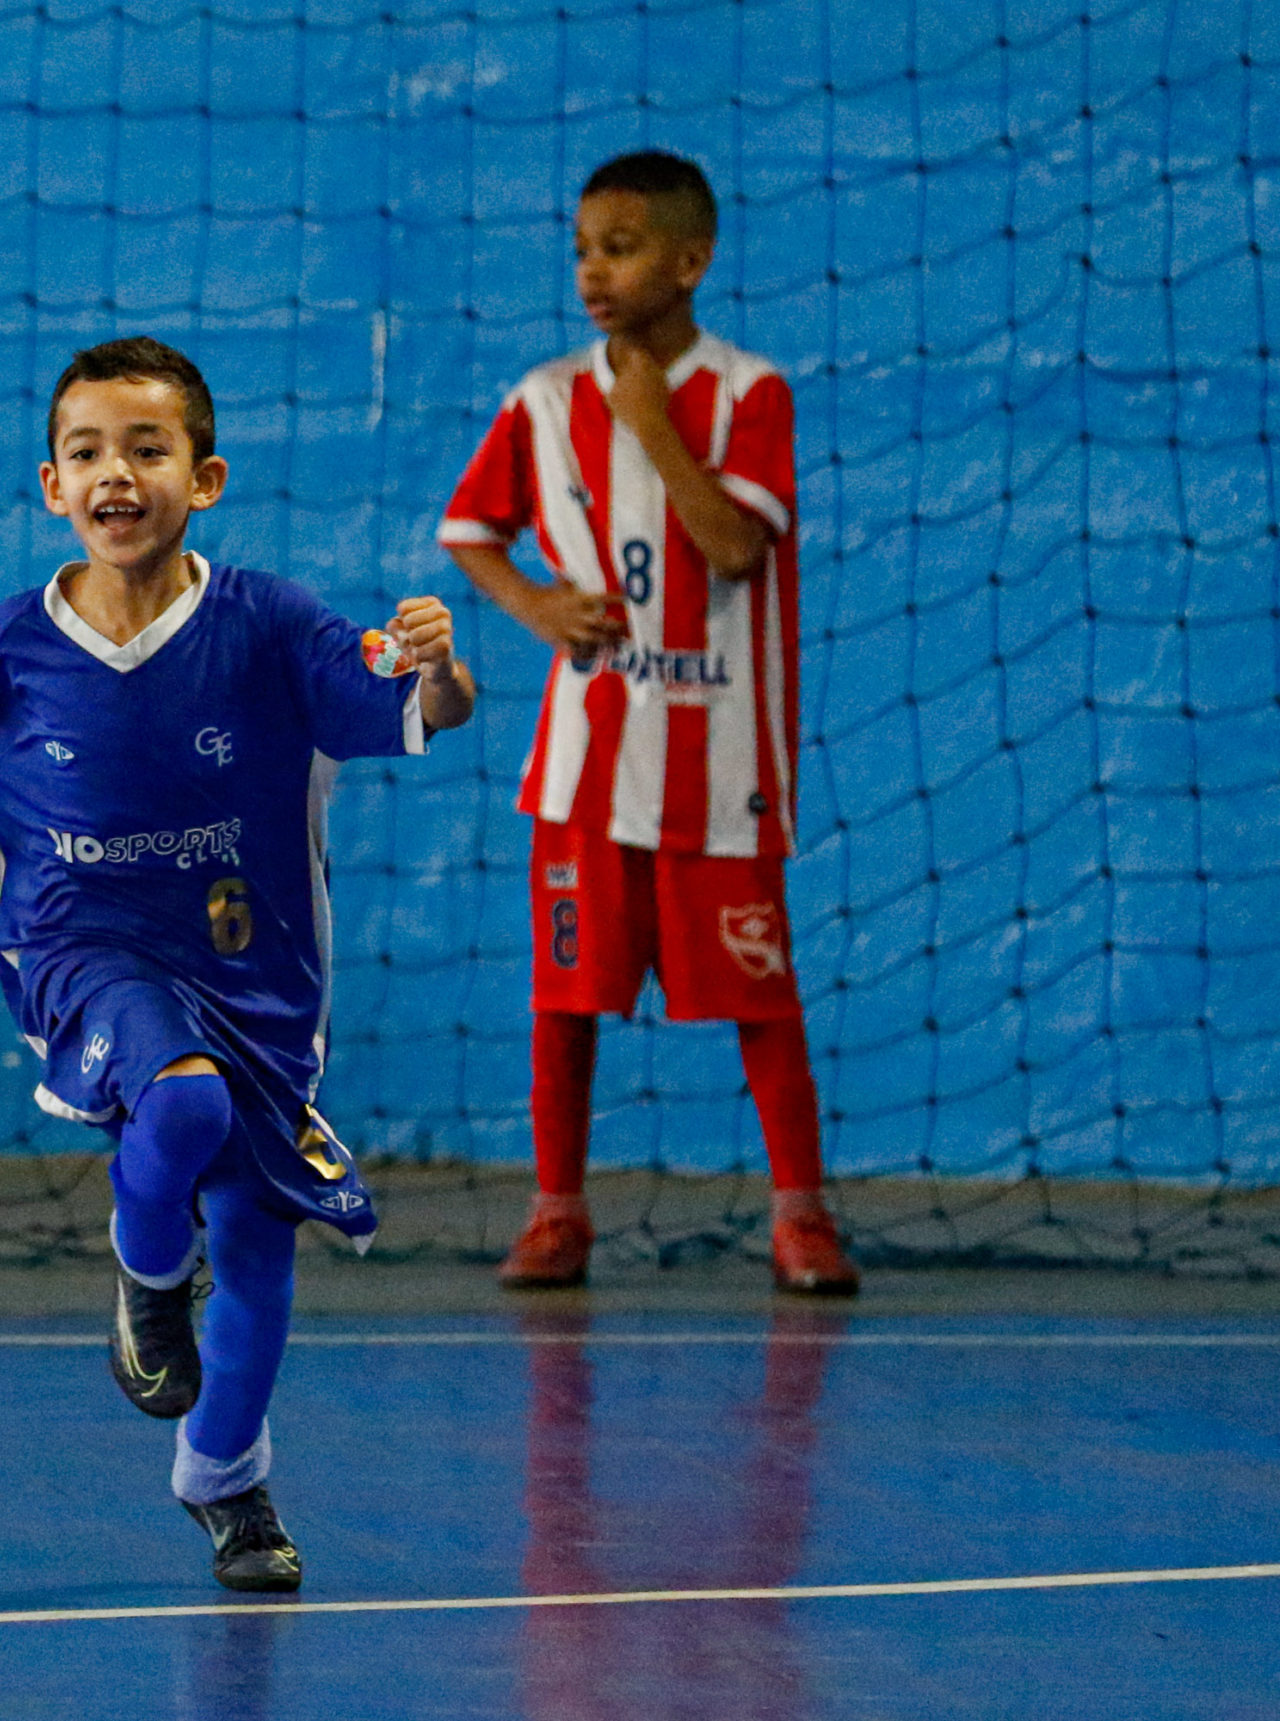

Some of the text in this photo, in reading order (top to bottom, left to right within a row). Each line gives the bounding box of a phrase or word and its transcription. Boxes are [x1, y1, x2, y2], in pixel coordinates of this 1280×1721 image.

[623, 540, 652, 605] 8
[207, 878, 252, 954] 6
[552, 899, 578, 969] 8
